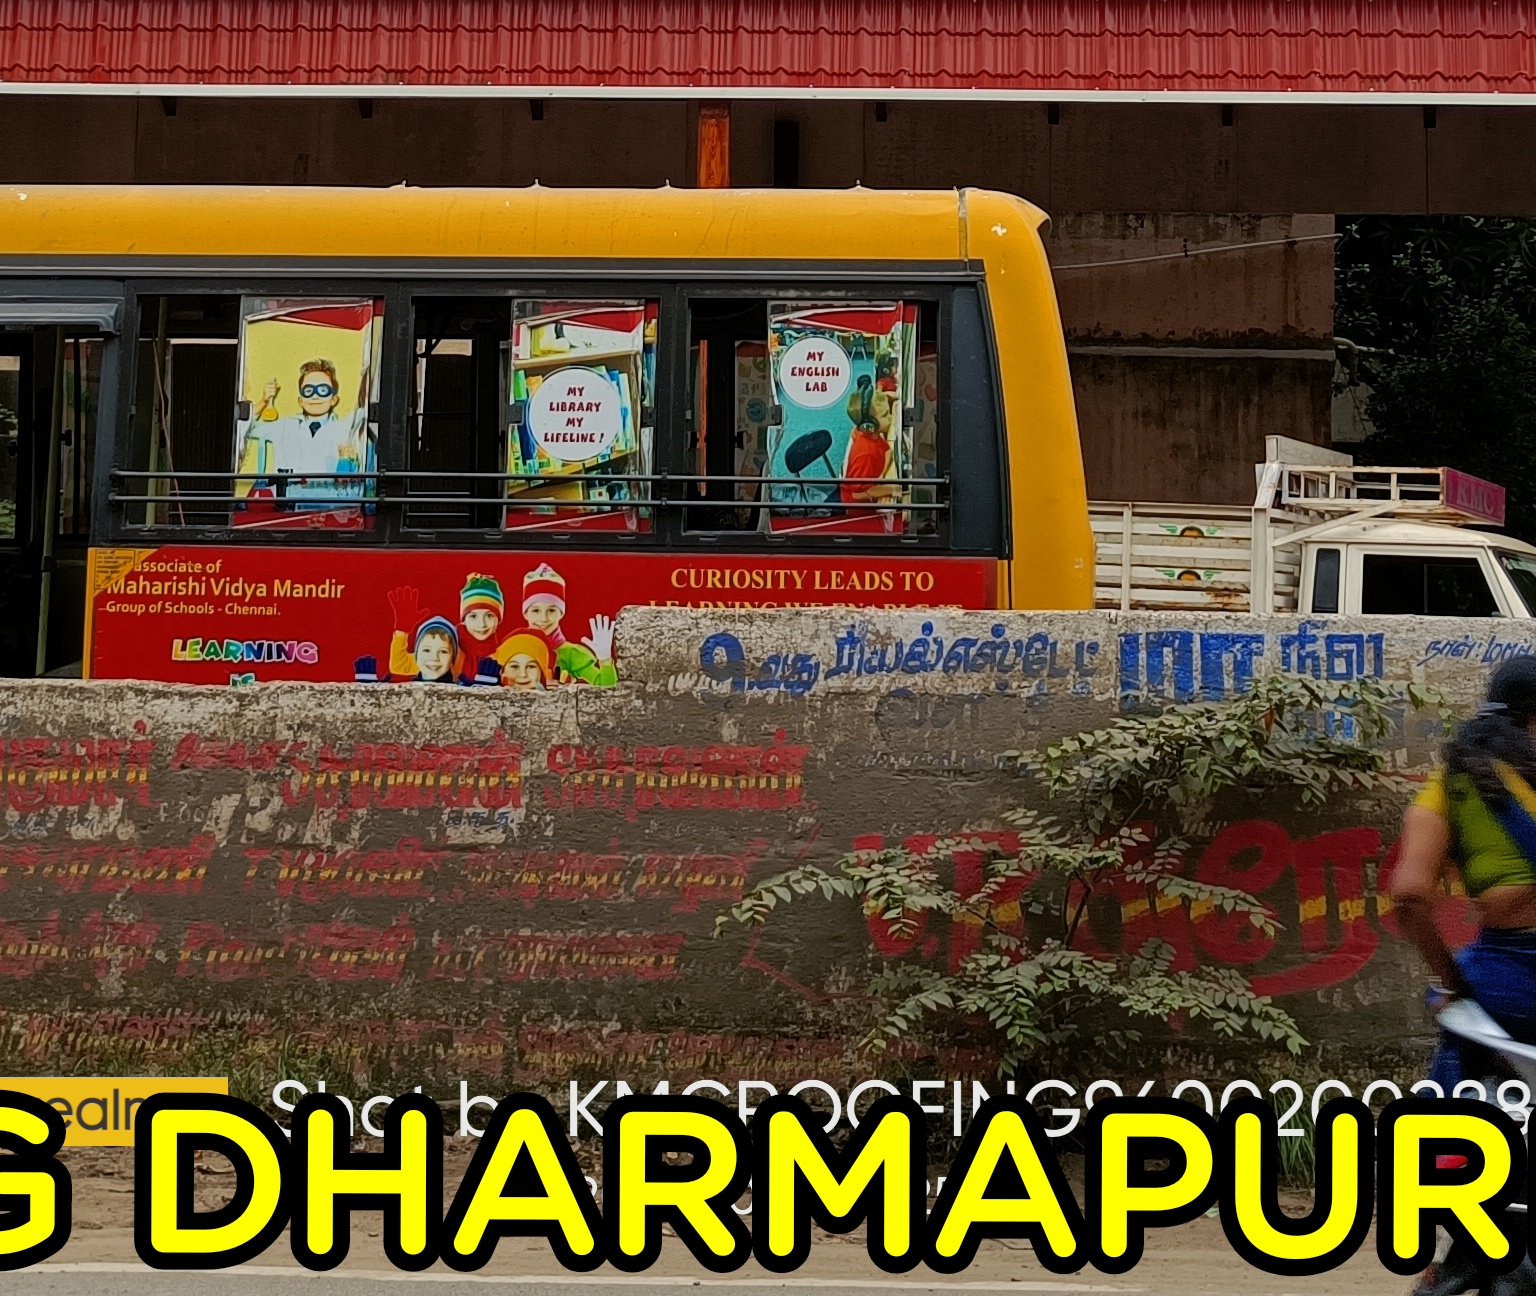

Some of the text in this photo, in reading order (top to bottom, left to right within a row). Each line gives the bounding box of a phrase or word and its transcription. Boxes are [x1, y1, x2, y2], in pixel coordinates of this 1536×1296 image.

[806, 351, 824, 362] MY
[790, 366, 840, 377] ENGLISH
[566, 386, 585, 397] MY
[805, 381, 828, 392] LAB
[549, 401, 602, 412] LIBRARY
[565, 417, 584, 427] MY
[543, 432, 595, 443] LIFELINE
[206, 558, 223, 573] of
[670, 568, 935, 592] CURIOSITY LEADS TO
[107, 574, 346, 603] Maharishi Vidya Mandir
[106, 600, 146, 616] Group
[149, 600, 163, 614] of
[164, 601, 215, 615] Schools
[224, 602, 282, 616] Chennai.
[171, 638, 319, 664] LEARNING
